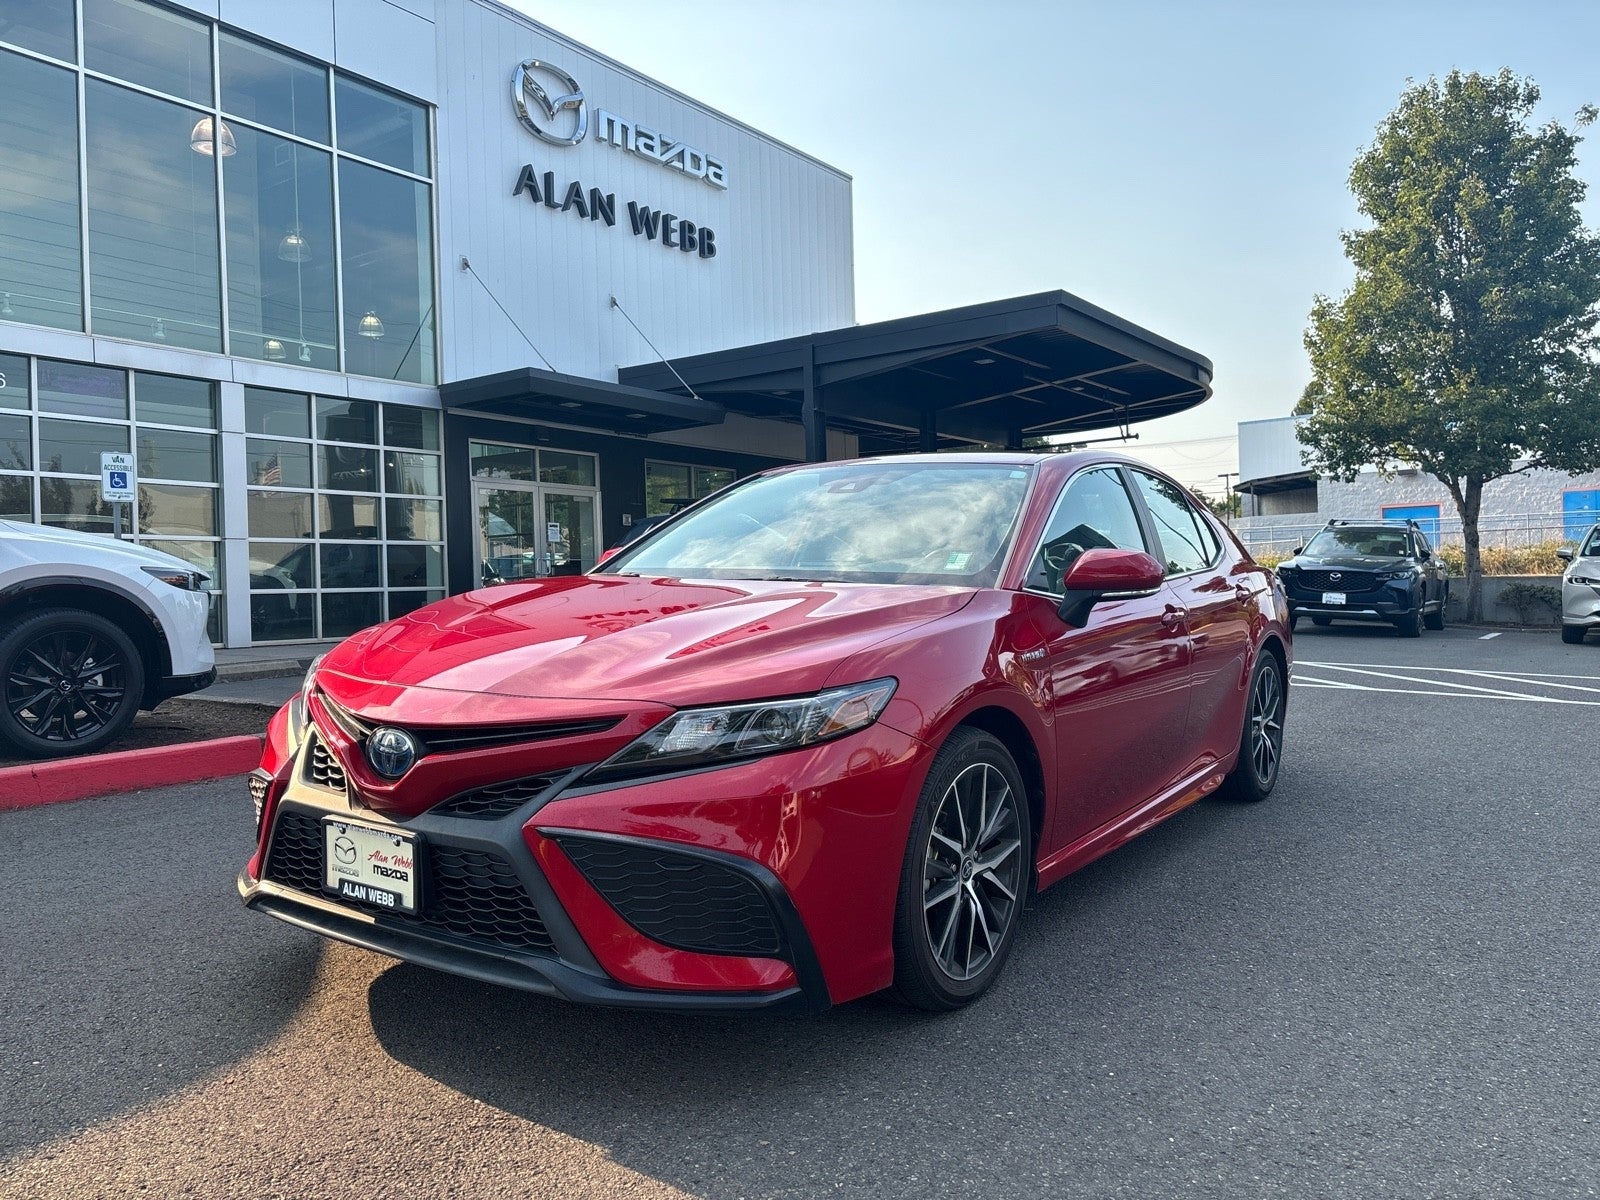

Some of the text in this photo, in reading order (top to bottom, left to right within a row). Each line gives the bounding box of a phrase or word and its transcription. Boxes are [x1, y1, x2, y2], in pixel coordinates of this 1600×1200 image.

[595, 108, 728, 191] mazda
[512, 163, 717, 259] ALAN WEBB
[104, 464, 132, 472] ACCESSIBLE
[112, 455, 124, 463] VAN
[367, 850, 412, 869] Alan Webb
[373, 864, 408, 882] mazda
[343, 882, 394, 906] ALAN WEBB
